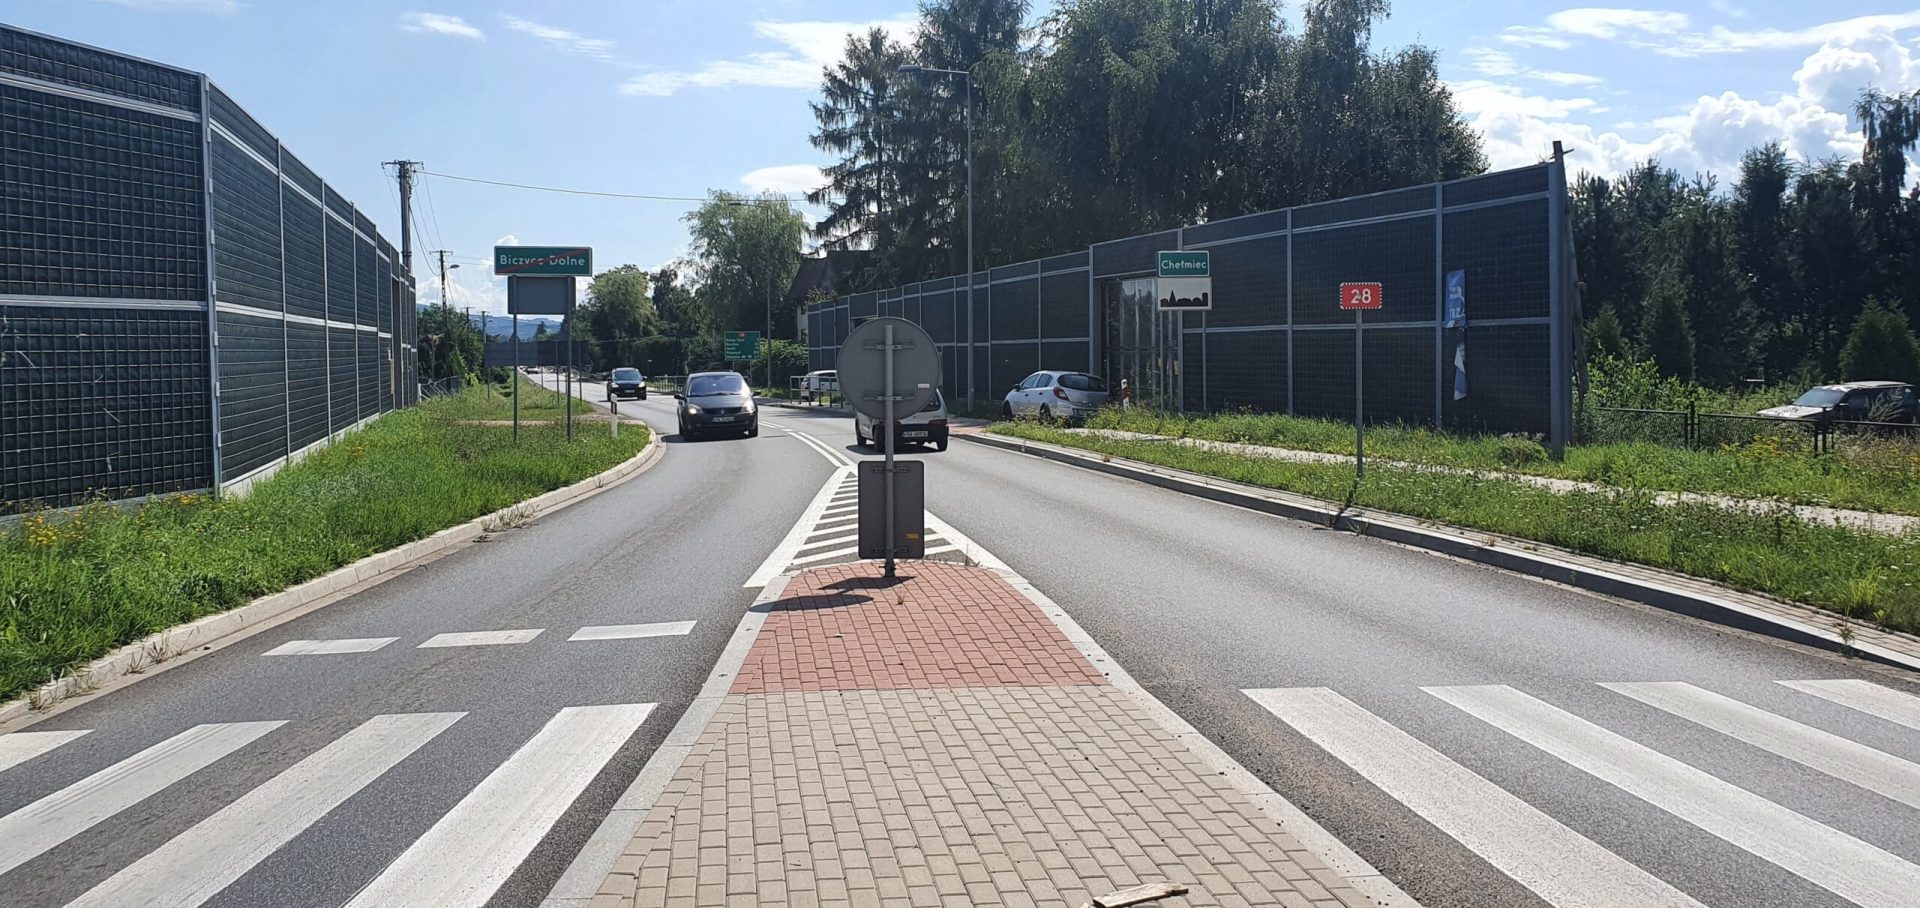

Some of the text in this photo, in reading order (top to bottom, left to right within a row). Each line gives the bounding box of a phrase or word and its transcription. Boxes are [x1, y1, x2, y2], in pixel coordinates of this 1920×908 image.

[549, 255, 585, 266] Dolne
[1161, 259, 1207, 269] Chełmiec
[1350, 288, 1372, 304] 28
